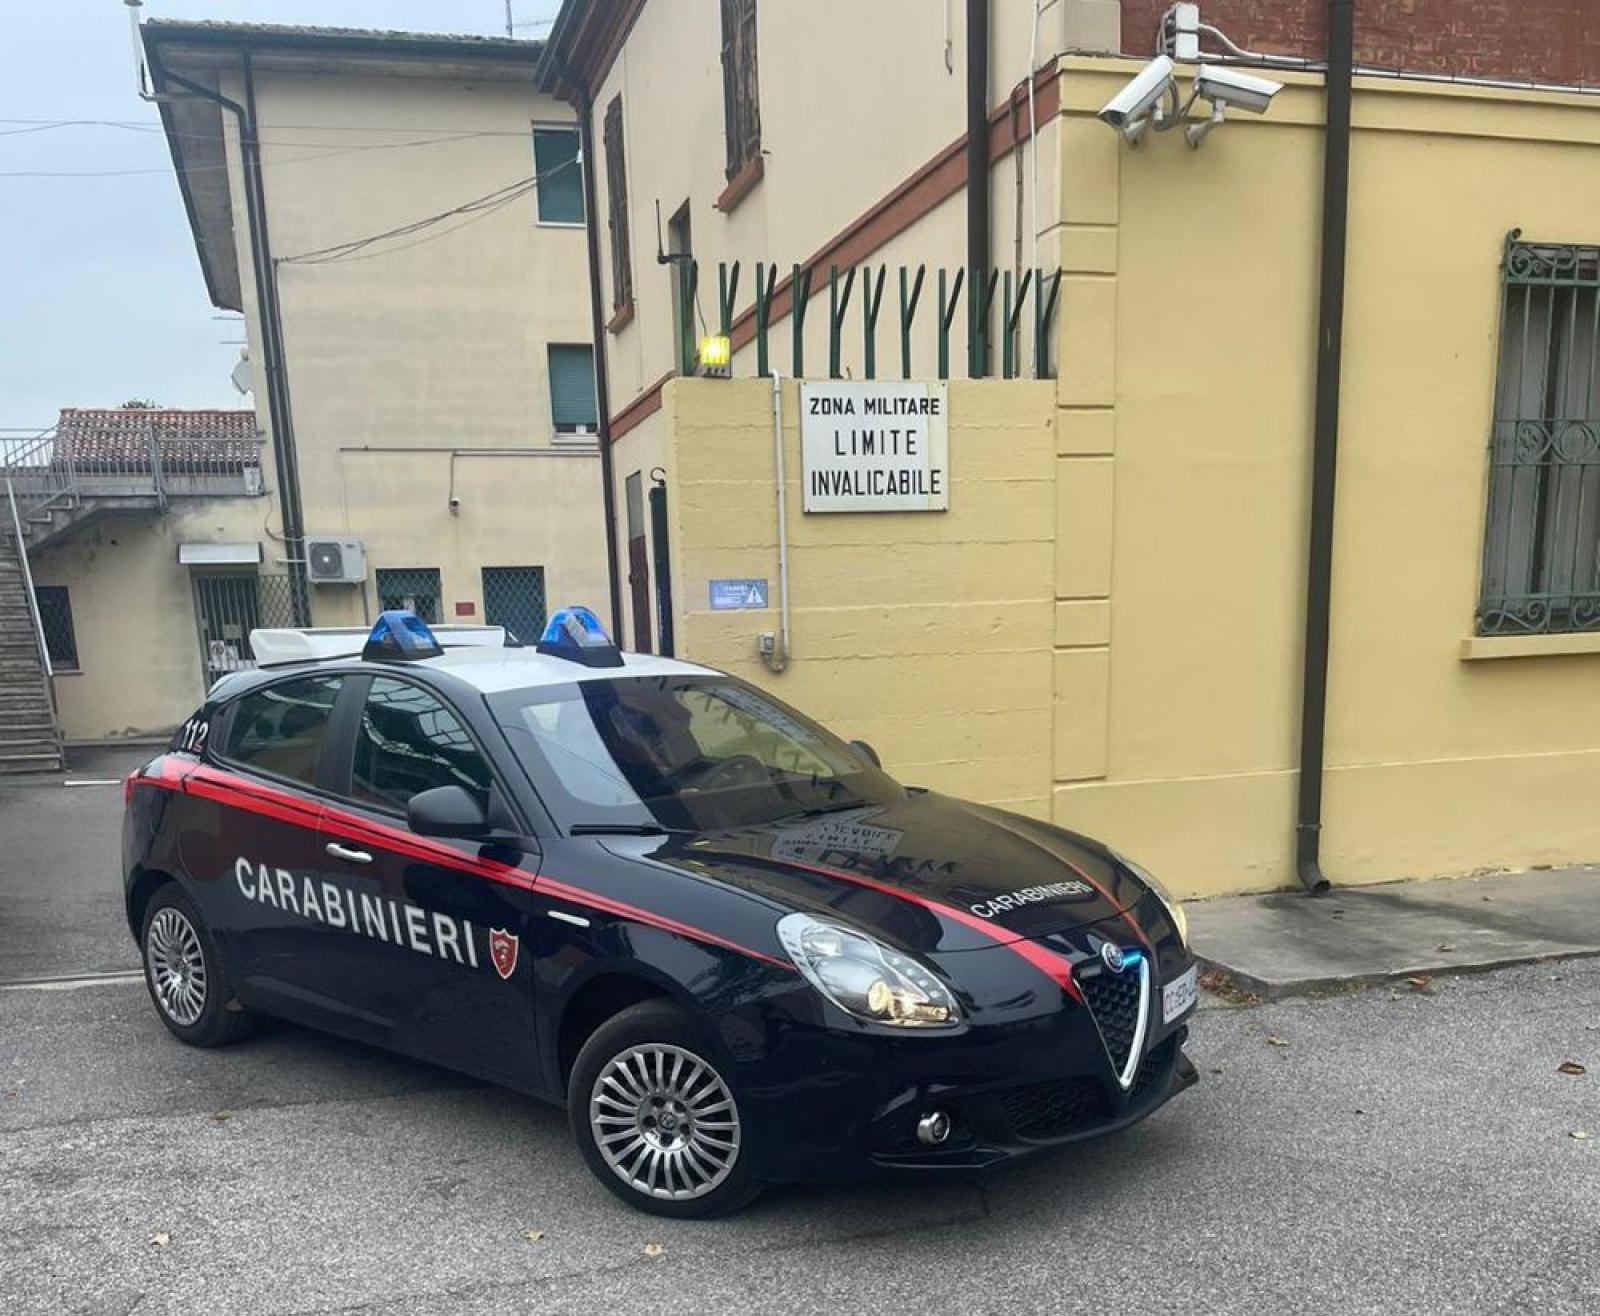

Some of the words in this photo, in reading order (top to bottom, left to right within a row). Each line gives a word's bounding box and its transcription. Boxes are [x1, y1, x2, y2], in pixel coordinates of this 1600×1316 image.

[809, 397, 855, 415] ZONA
[864, 397, 941, 415] MILITARE
[834, 429, 918, 456] LIMITE
[811, 469, 942, 496] INVALICABILE
[181, 719, 209, 753] 112
[234, 857, 479, 969] CARABINIERI
